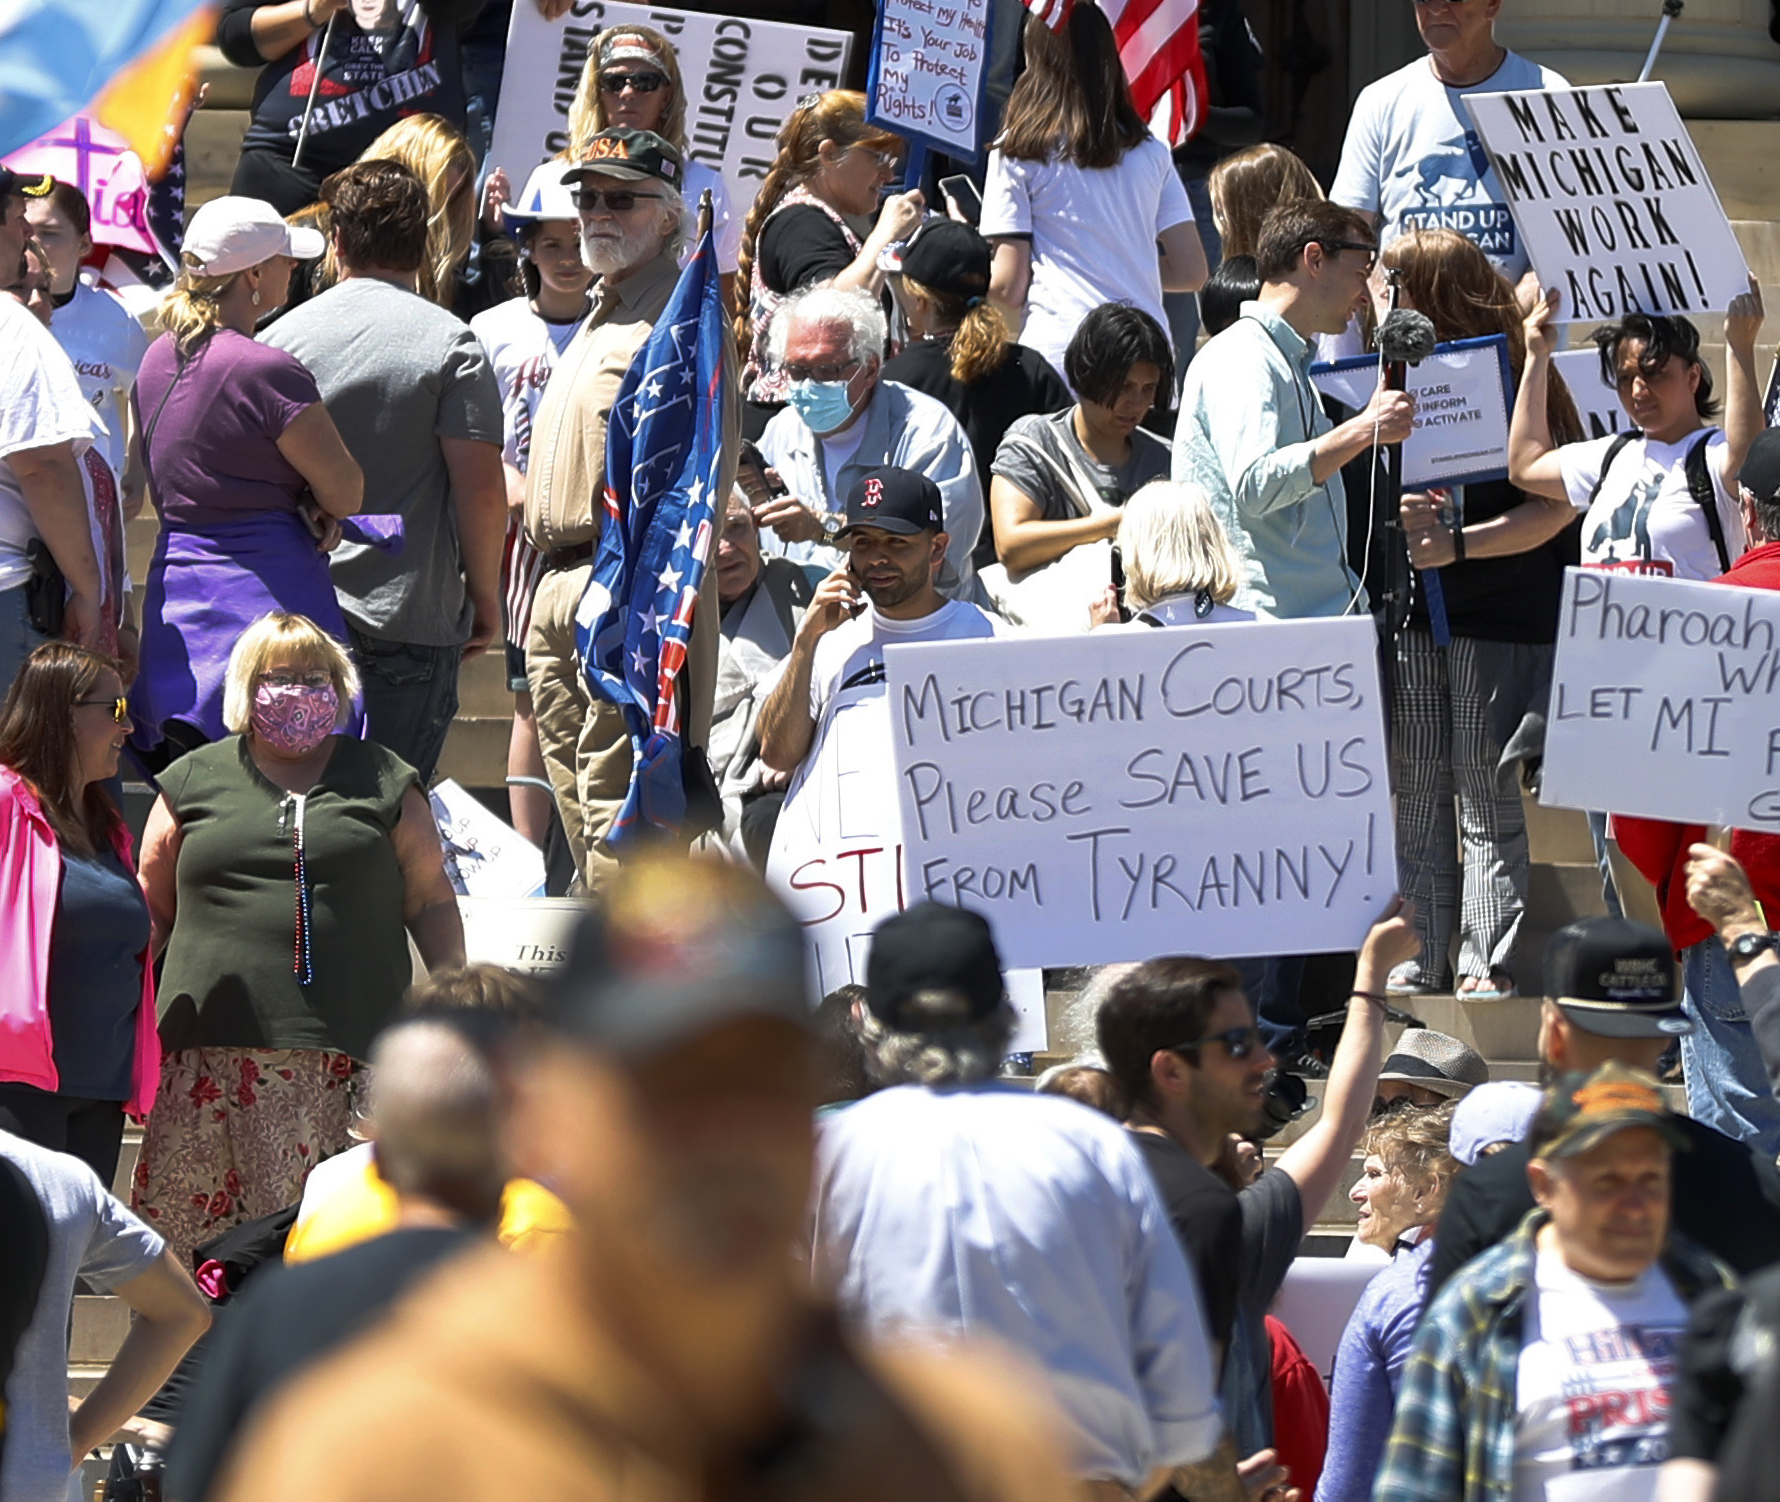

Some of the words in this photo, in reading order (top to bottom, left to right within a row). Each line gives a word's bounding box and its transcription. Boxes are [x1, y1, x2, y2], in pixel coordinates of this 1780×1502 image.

[883, 15, 912, 40] It's
[920, 25, 954, 50] Your
[953, 42, 978, 62] Job
[342, 71, 386, 81] STATE
[687, 17, 753, 173] CONSTITU
[911, 49, 969, 87] Protect
[287, 58, 442, 139] GRETCHEN
[876, 82, 936, 126] Rights!
[1500, 86, 1640, 144] MAKE
[1494, 136, 1698, 202] MICHIGAN
[1478, 209, 1510, 228] UP
[1554, 195, 1680, 257] WORK
[1565, 248, 1711, 322] AGAIN!
[1420, 383, 1451, 398] CARE
[1422, 396, 1467, 412] INFORM
[1424, 409, 1483, 428] ACTIVATE
[1569, 573, 1775, 652] Pharoah
[1555, 682, 1645, 723] LET
[1650, 696, 1734, 758] MI
[902, 760, 1092, 842] Please
[1118, 746, 1271, 813] SAVE
[1294, 735, 1374, 799] US
[918, 856, 1044, 910] FROM
[1065, 811, 1377, 924] TYRANNY!
[515, 944, 569, 964] This
